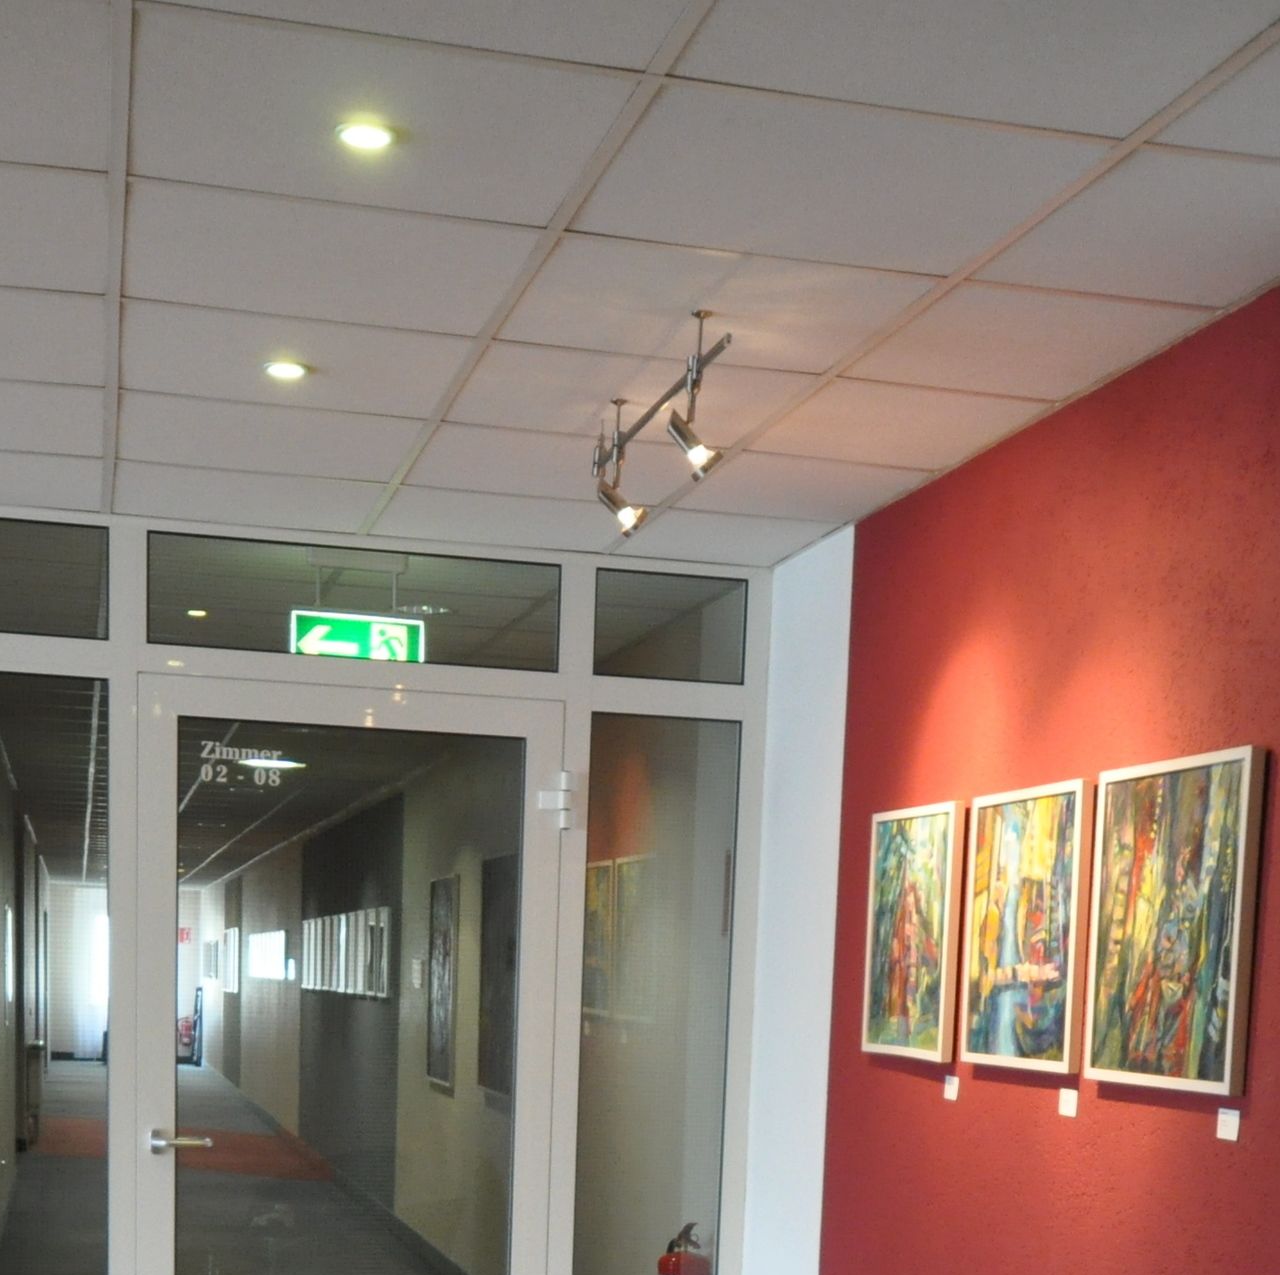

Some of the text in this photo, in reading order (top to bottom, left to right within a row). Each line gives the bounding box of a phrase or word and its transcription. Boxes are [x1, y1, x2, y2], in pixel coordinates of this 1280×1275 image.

[200, 740, 282, 760] Zimmer
[200, 764, 228, 782] 02
[254, 768, 281, 787] 08
